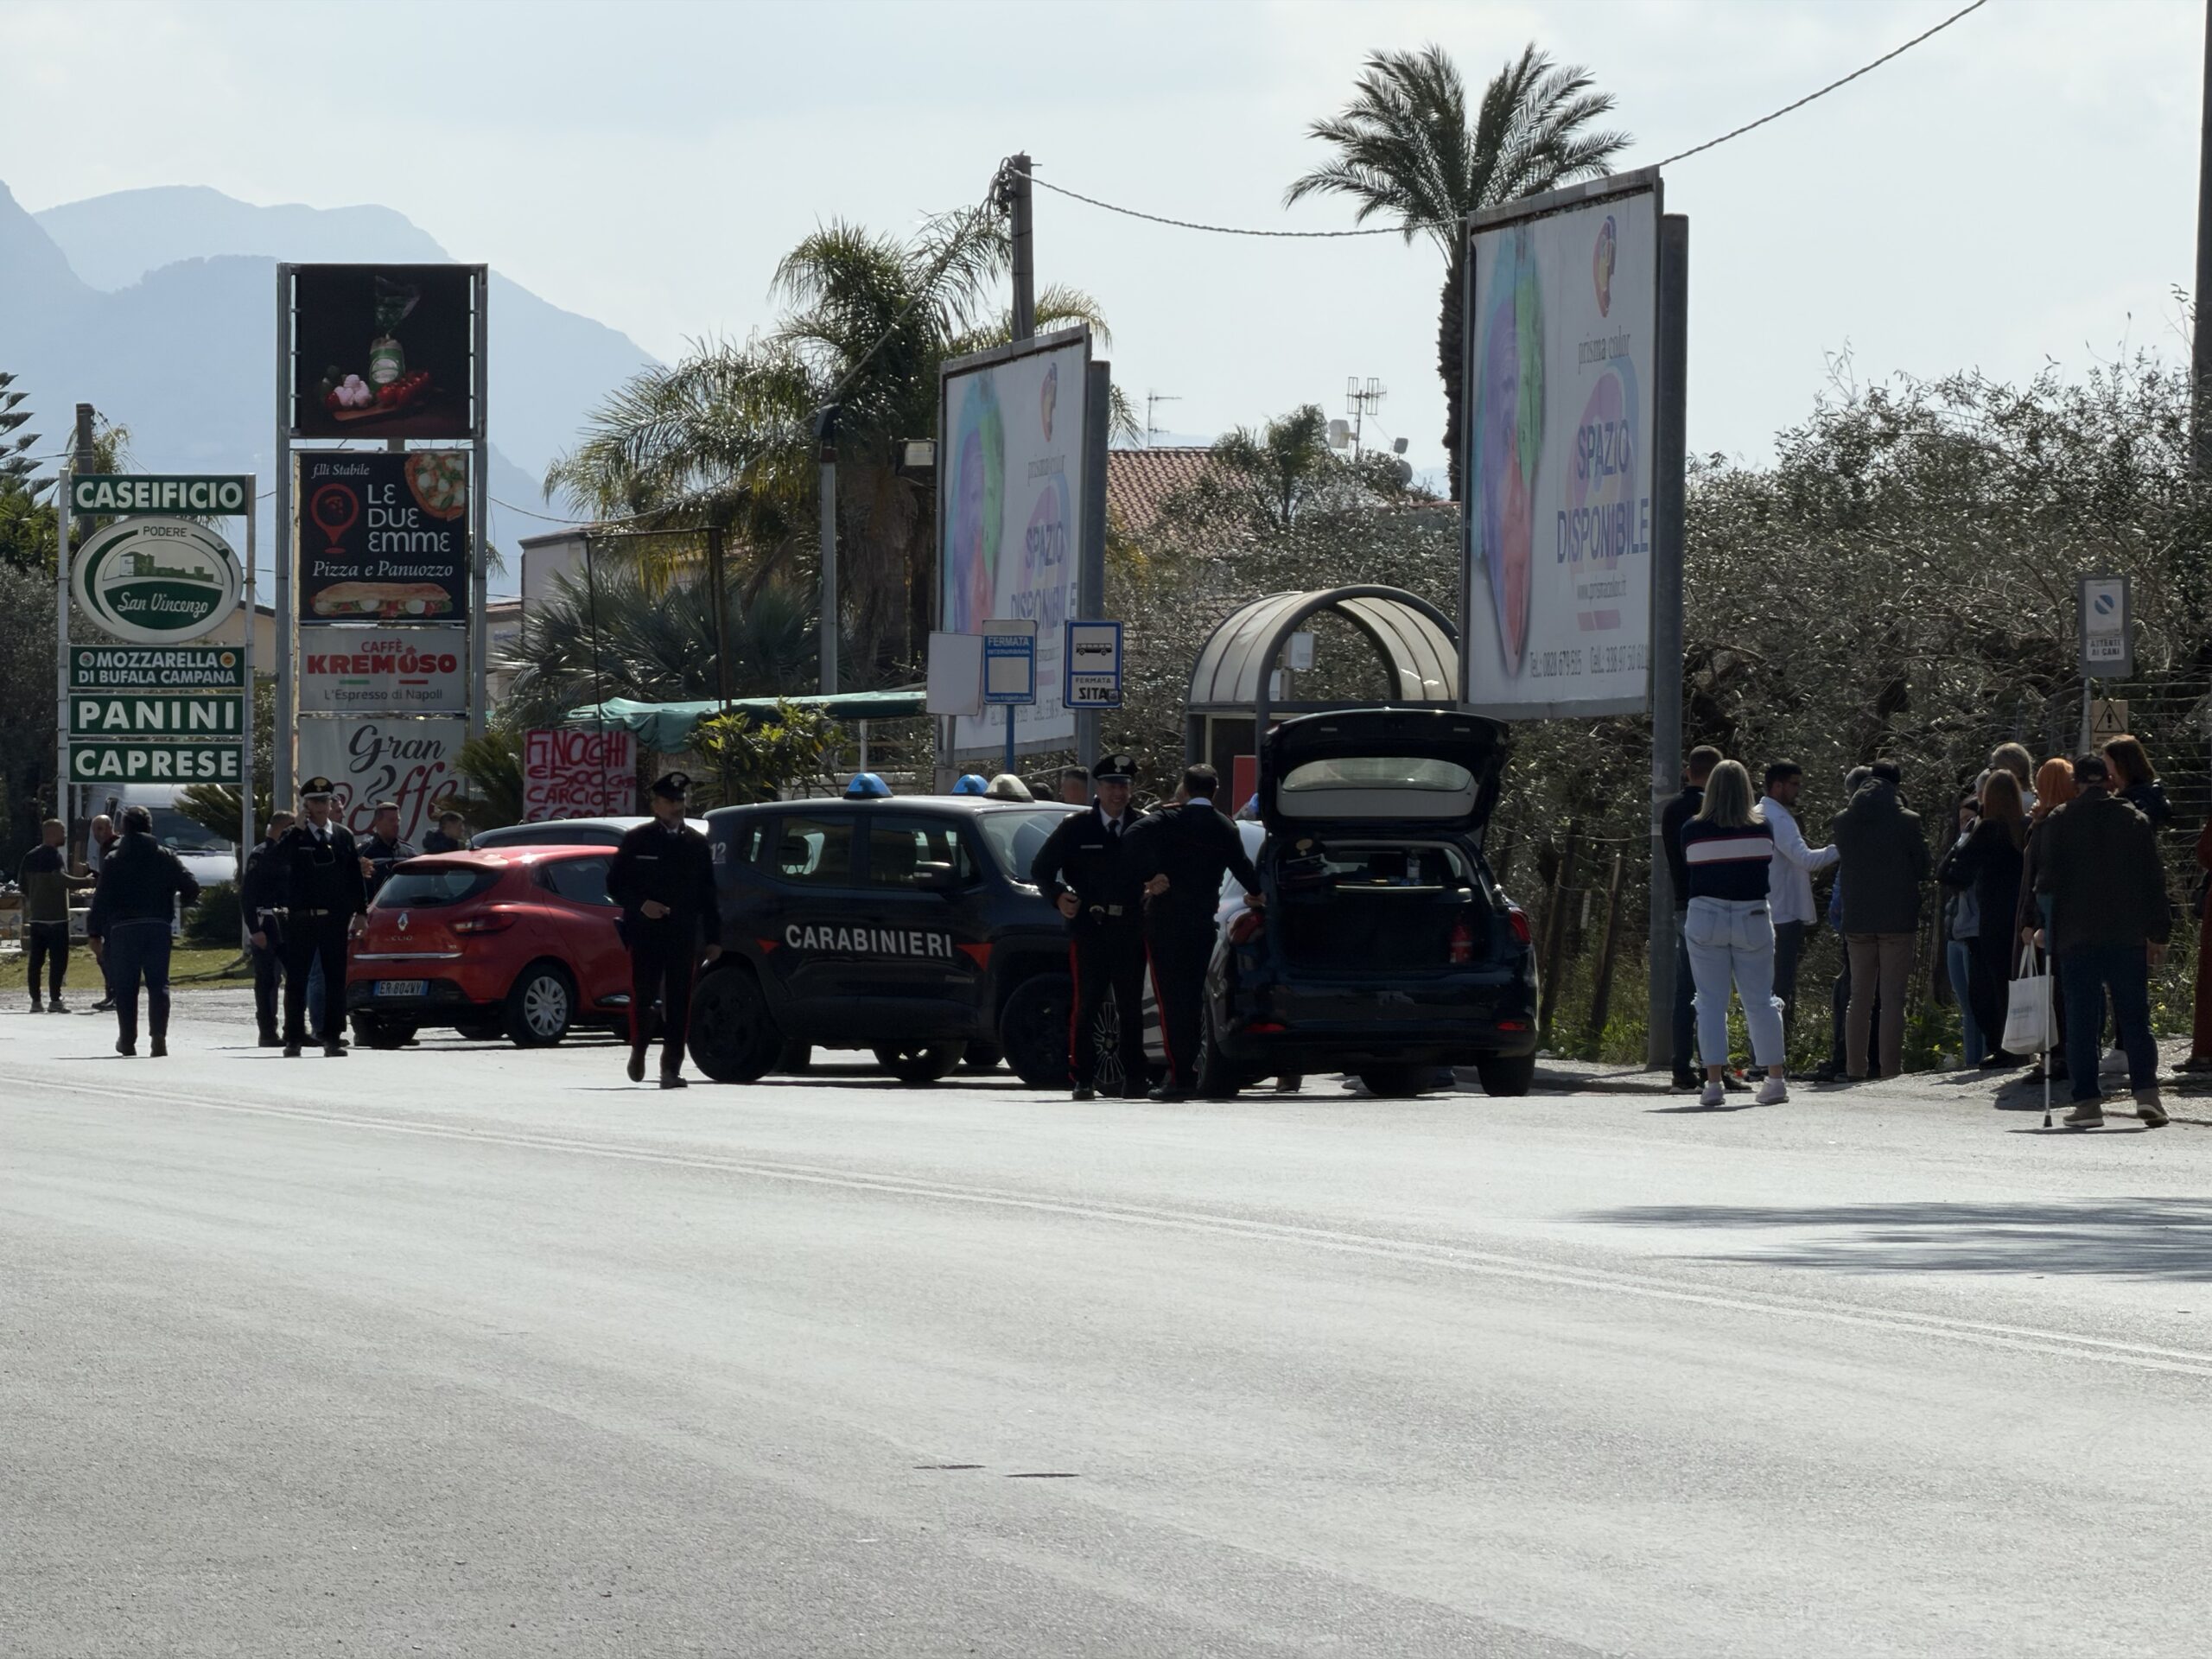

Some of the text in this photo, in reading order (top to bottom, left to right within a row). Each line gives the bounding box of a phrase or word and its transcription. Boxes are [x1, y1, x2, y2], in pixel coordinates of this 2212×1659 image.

[1578, 419, 1630, 480] SPAZIO
[333, 464, 370, 476] Stabile
[76, 481, 243, 509] CASEIFICIO
[367, 484, 396, 504] LE
[368, 507, 419, 528] DUE
[143, 526, 188, 537] PODERE
[1557, 498, 1649, 563] DISPONIBILE
[313, 561, 453, 577] Pizza e Panuozzo
[118, 592, 208, 617] San Vincenzo
[361, 638, 403, 653] CAFFÈ
[988, 636, 1030, 647] FERMATA
[97, 652, 218, 669] MOZZARELLA
[79, 670, 236, 683] DI BUFALA CAMPANA
[324, 690, 442, 702] L'Espresso di Napoli
[1078, 688, 1108, 700] SITA
[79, 701, 235, 729] PANINI
[348, 724, 447, 773] Gran
[75, 750, 238, 778] CAPRESE
[526, 785, 629, 807] CARCIOFI
[785, 924, 952, 957] CARABINIERI
